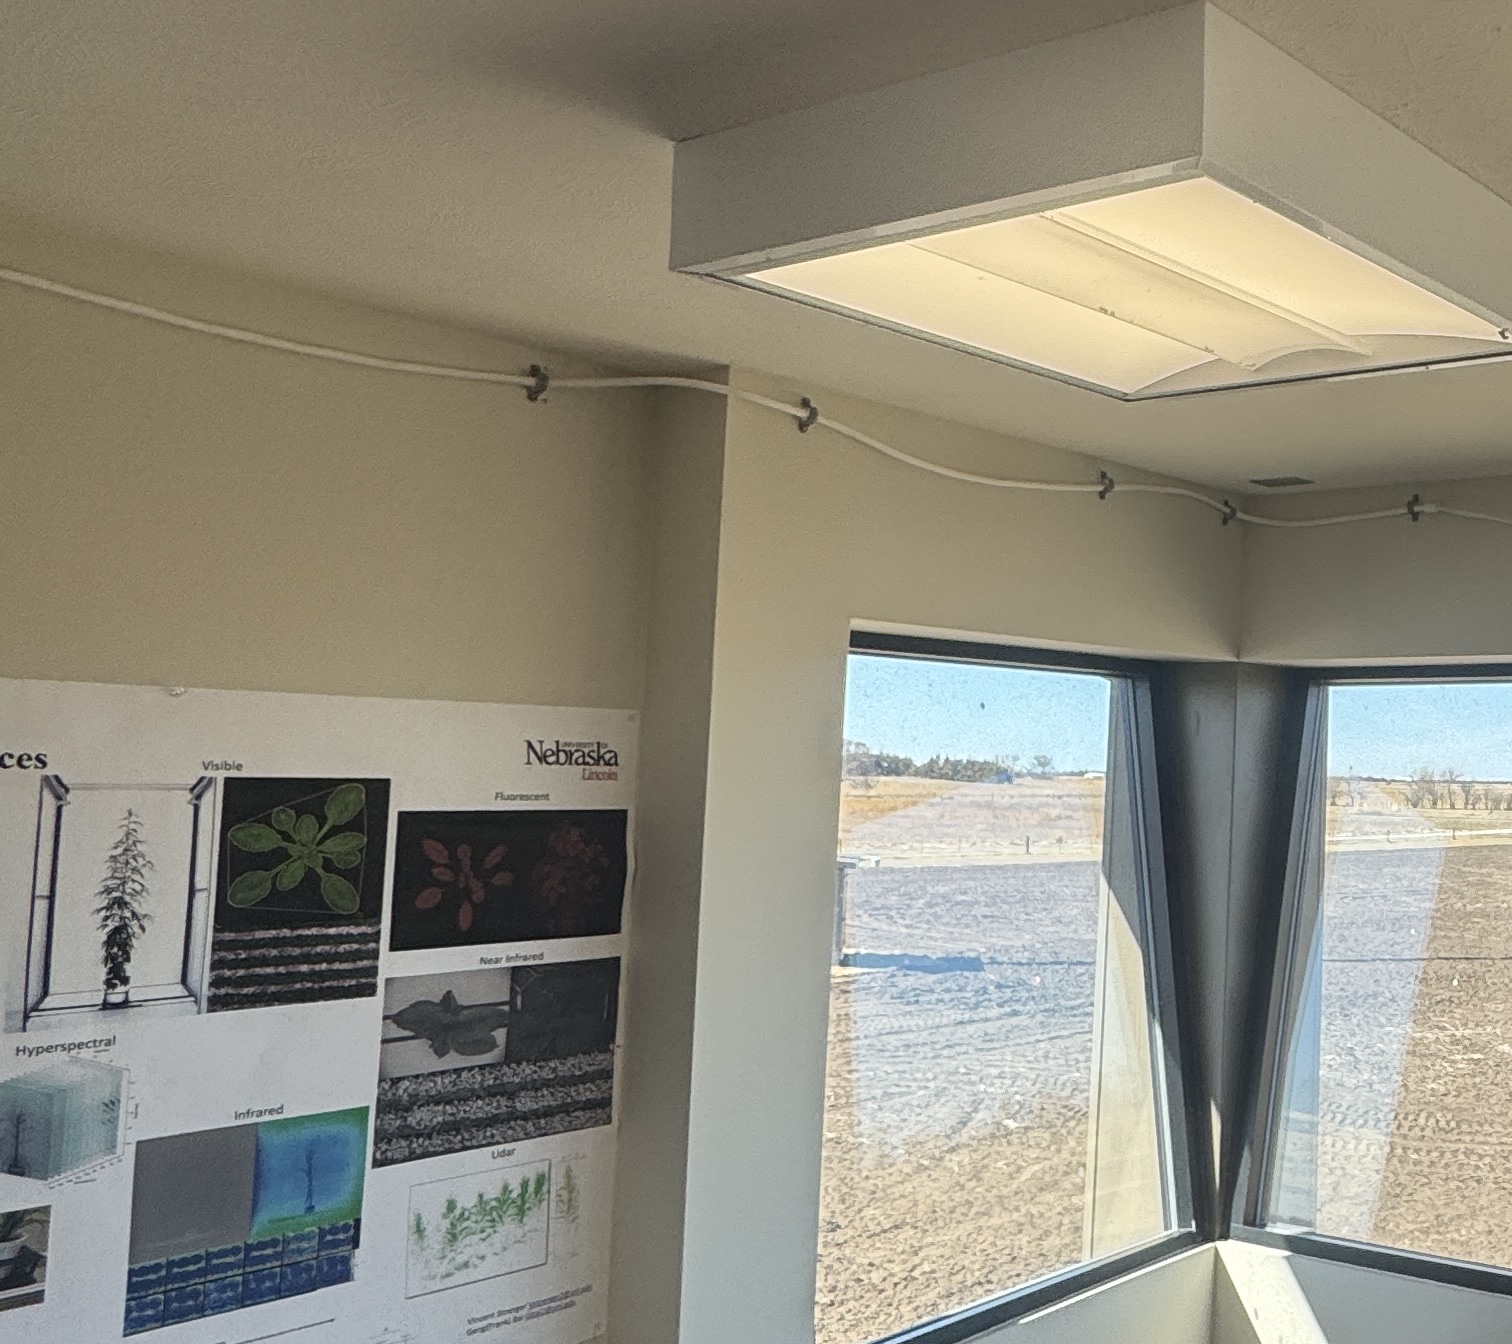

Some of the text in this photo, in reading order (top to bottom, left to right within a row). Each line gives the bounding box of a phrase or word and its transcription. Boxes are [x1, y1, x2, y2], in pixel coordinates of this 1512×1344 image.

[0, 751, 48, 770] ces
[524, 739, 619, 767] Nebraska
[202, 760, 244, 772] Visible
[494, 791, 551, 802] Fluorescent
[479, 951, 545, 966] Near Infrared
[15, 1035, 117, 1058] Hyperspectral
[233, 1104, 285, 1122] Infrared
[491, 1147, 517, 1160] Lidar
